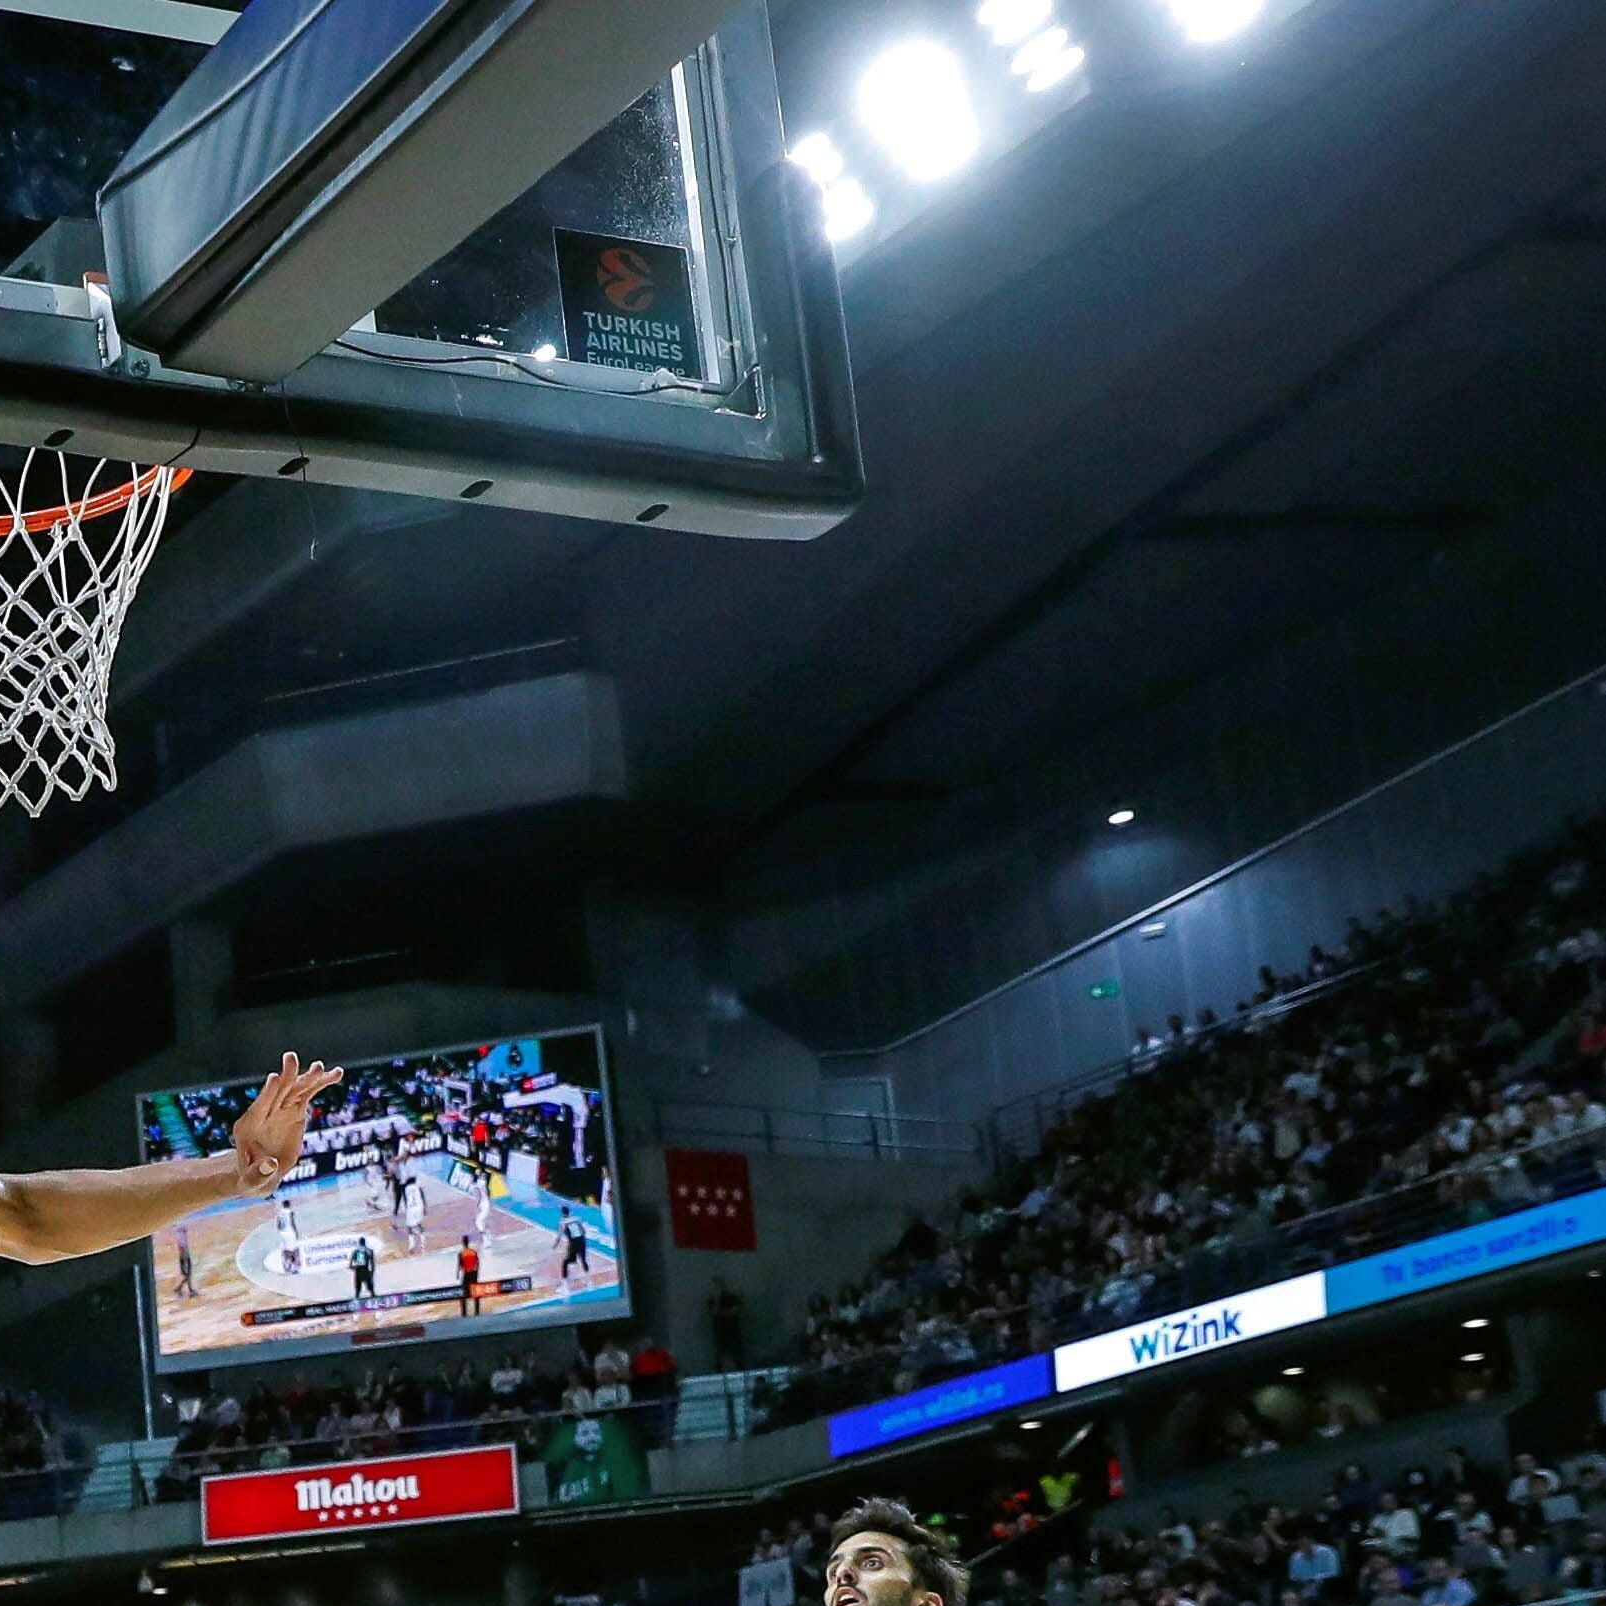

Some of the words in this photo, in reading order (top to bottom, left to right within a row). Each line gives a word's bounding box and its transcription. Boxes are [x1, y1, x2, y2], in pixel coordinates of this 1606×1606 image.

[583, 311, 681, 342] TURKISH
[586, 333, 683, 362] AIRLINES
[1129, 1308, 1242, 1365] WiZink
[294, 1472, 420, 1511] Mahou
